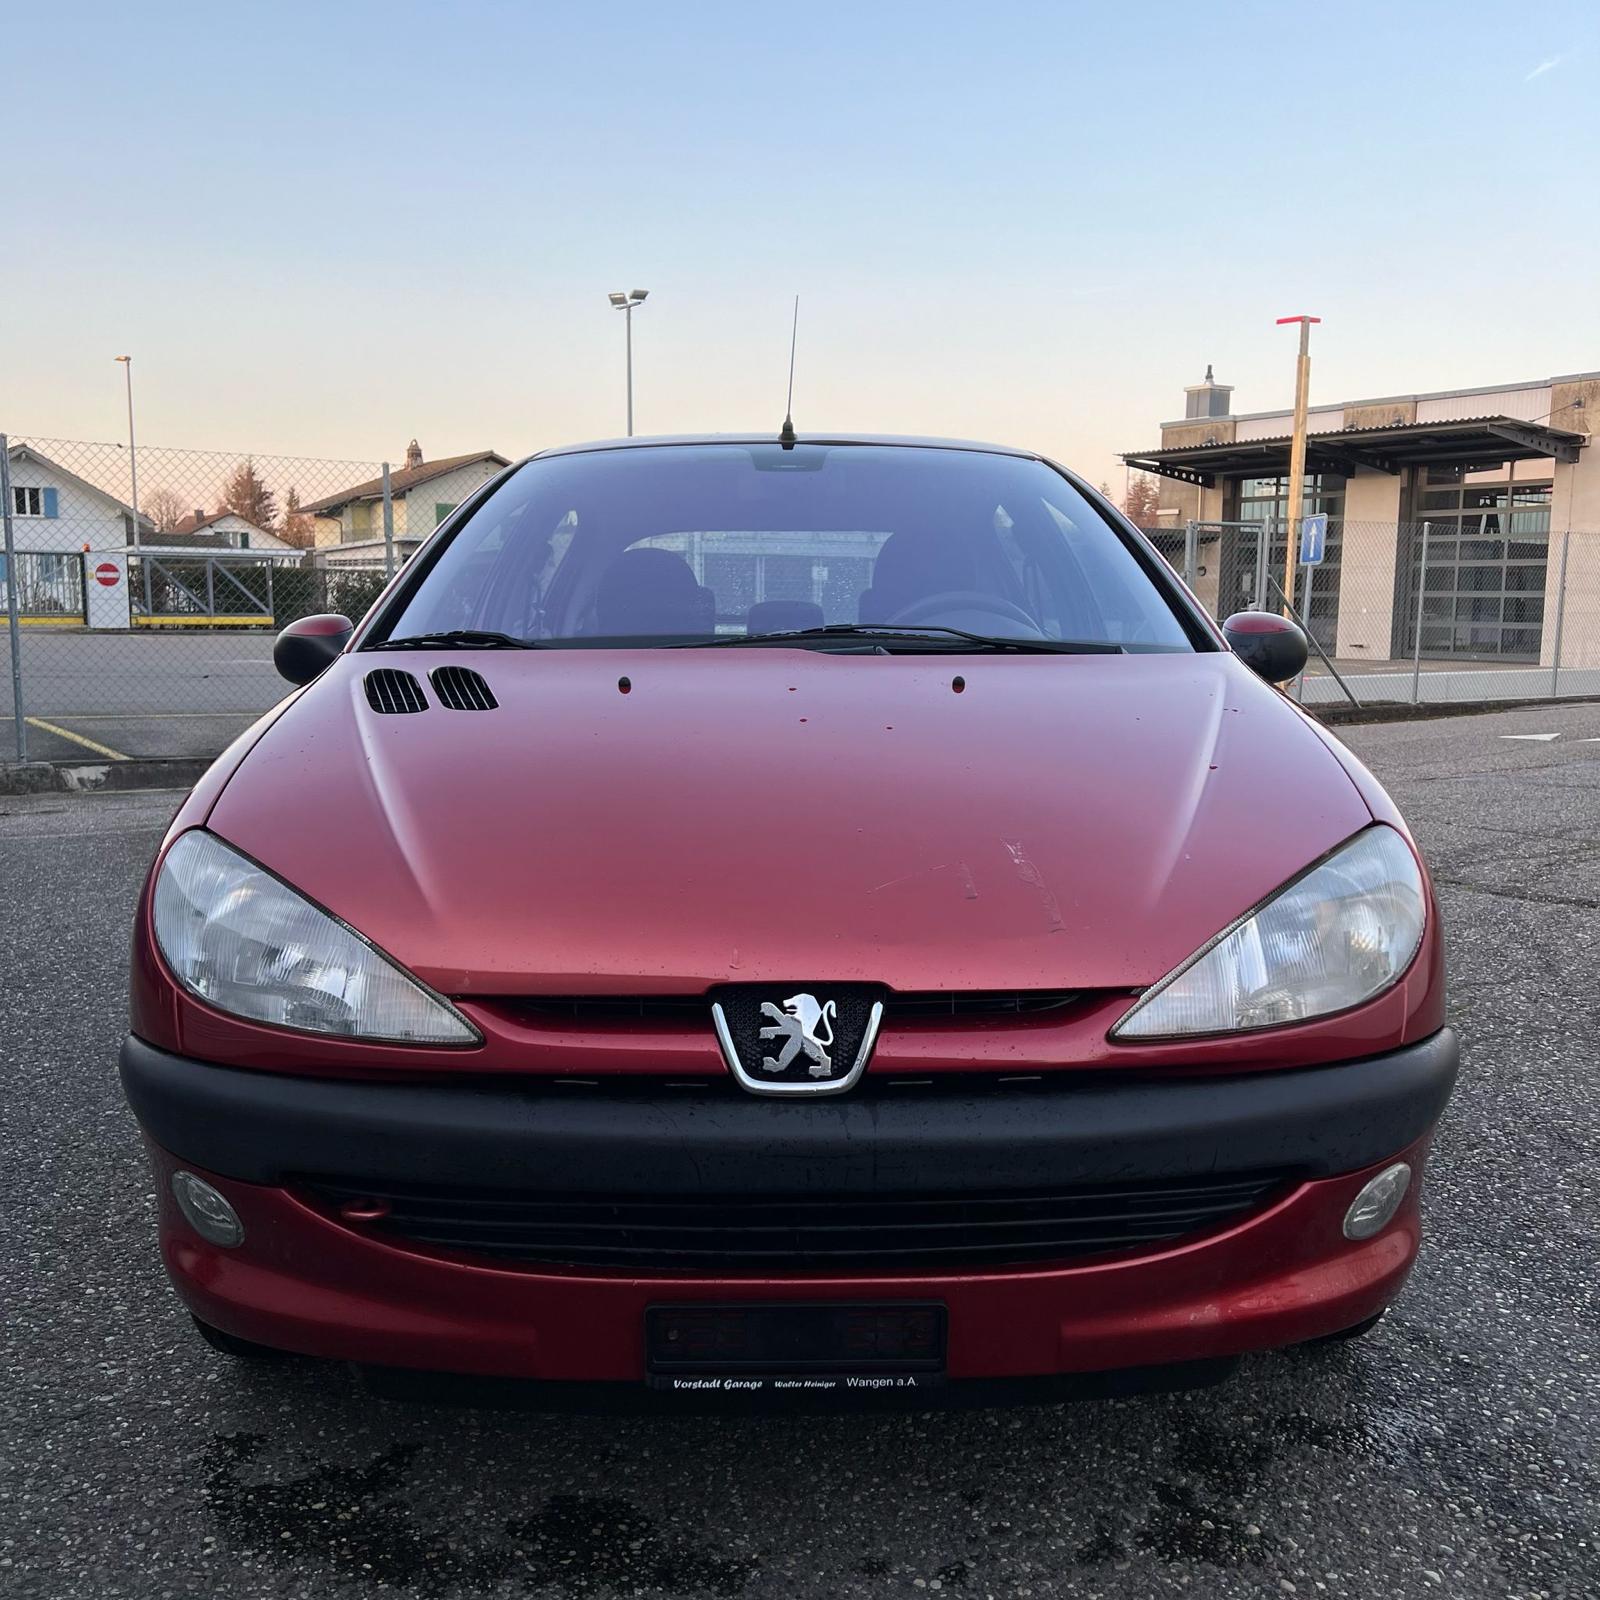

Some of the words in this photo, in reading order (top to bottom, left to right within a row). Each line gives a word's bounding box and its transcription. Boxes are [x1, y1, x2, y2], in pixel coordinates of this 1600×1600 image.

[673, 1379, 721, 1390] Vorstadt
[723, 1379, 763, 1391] Garage
[803, 1381, 837, 1390] Heiniger
[846, 1378, 894, 1389] Wangen
